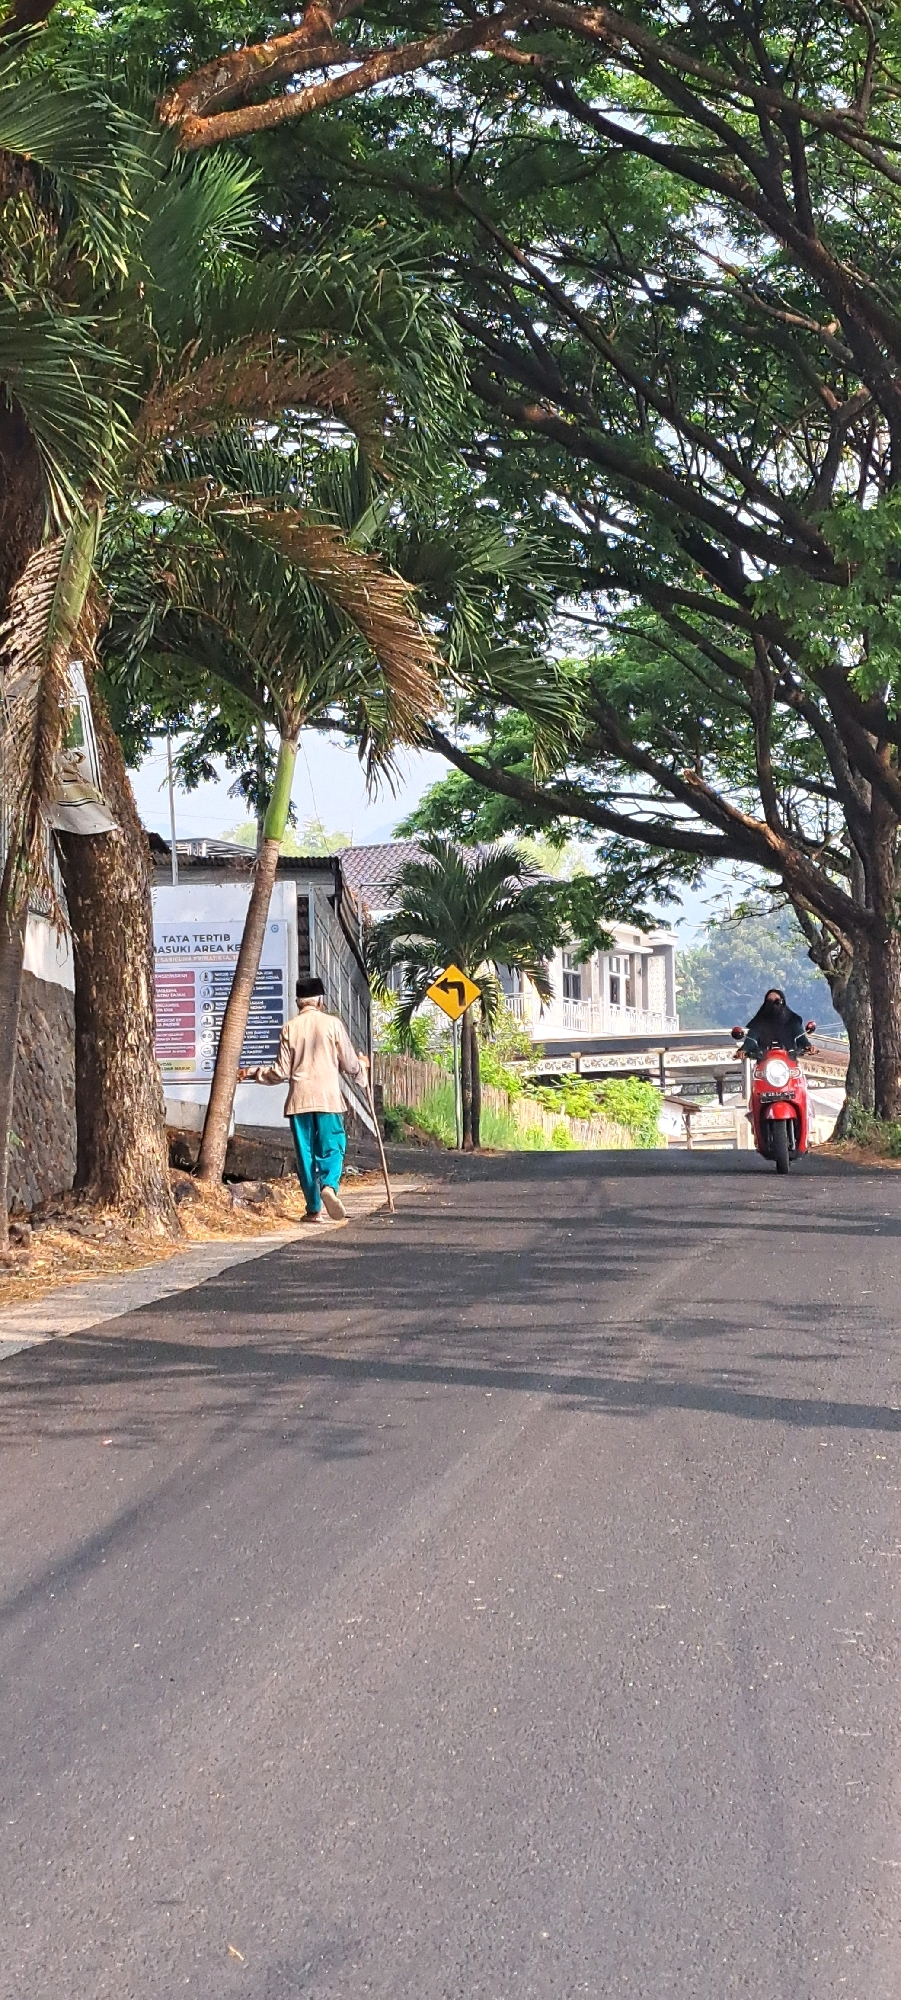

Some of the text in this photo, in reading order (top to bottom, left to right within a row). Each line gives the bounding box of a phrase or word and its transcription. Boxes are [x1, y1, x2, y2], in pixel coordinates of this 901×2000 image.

[162, 934, 231, 943] TATA TERTIB
[193, 944, 224, 953] AREA
